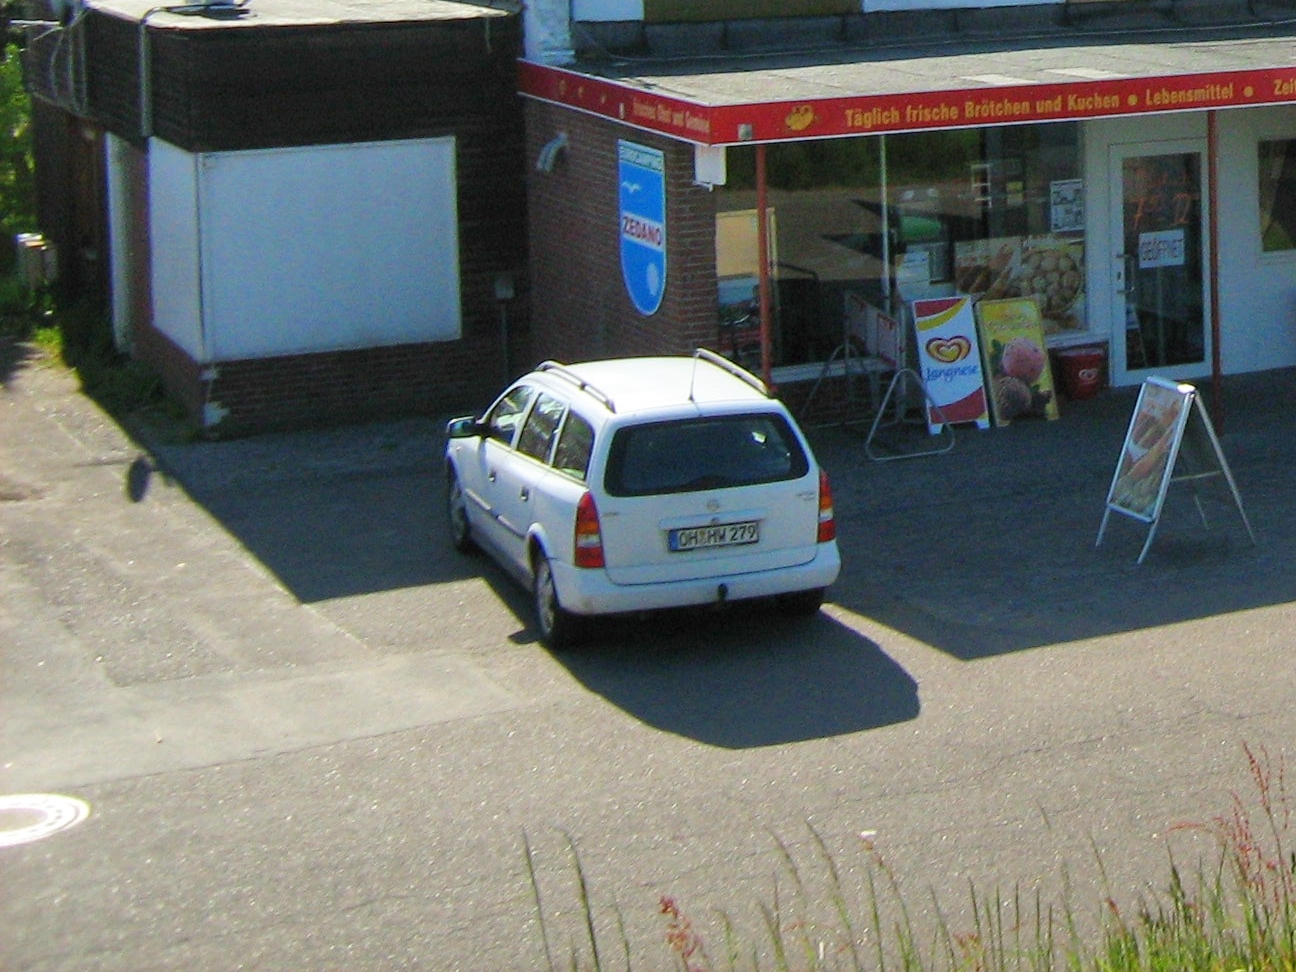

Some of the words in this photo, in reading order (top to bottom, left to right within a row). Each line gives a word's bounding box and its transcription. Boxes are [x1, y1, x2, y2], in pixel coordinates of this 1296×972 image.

[845, 106, 900, 129] Täglich
[905, 103, 958, 123] frische
[965, 98, 1030, 119] Brötchen
[1036, 95, 1061, 113] und
[1067, 91, 1119, 112] Kuchen
[1146, 82, 1234, 106] Lebensmittel
[622, 216, 663, 246] ZEDANO
[730, 524, 756, 542] 279
